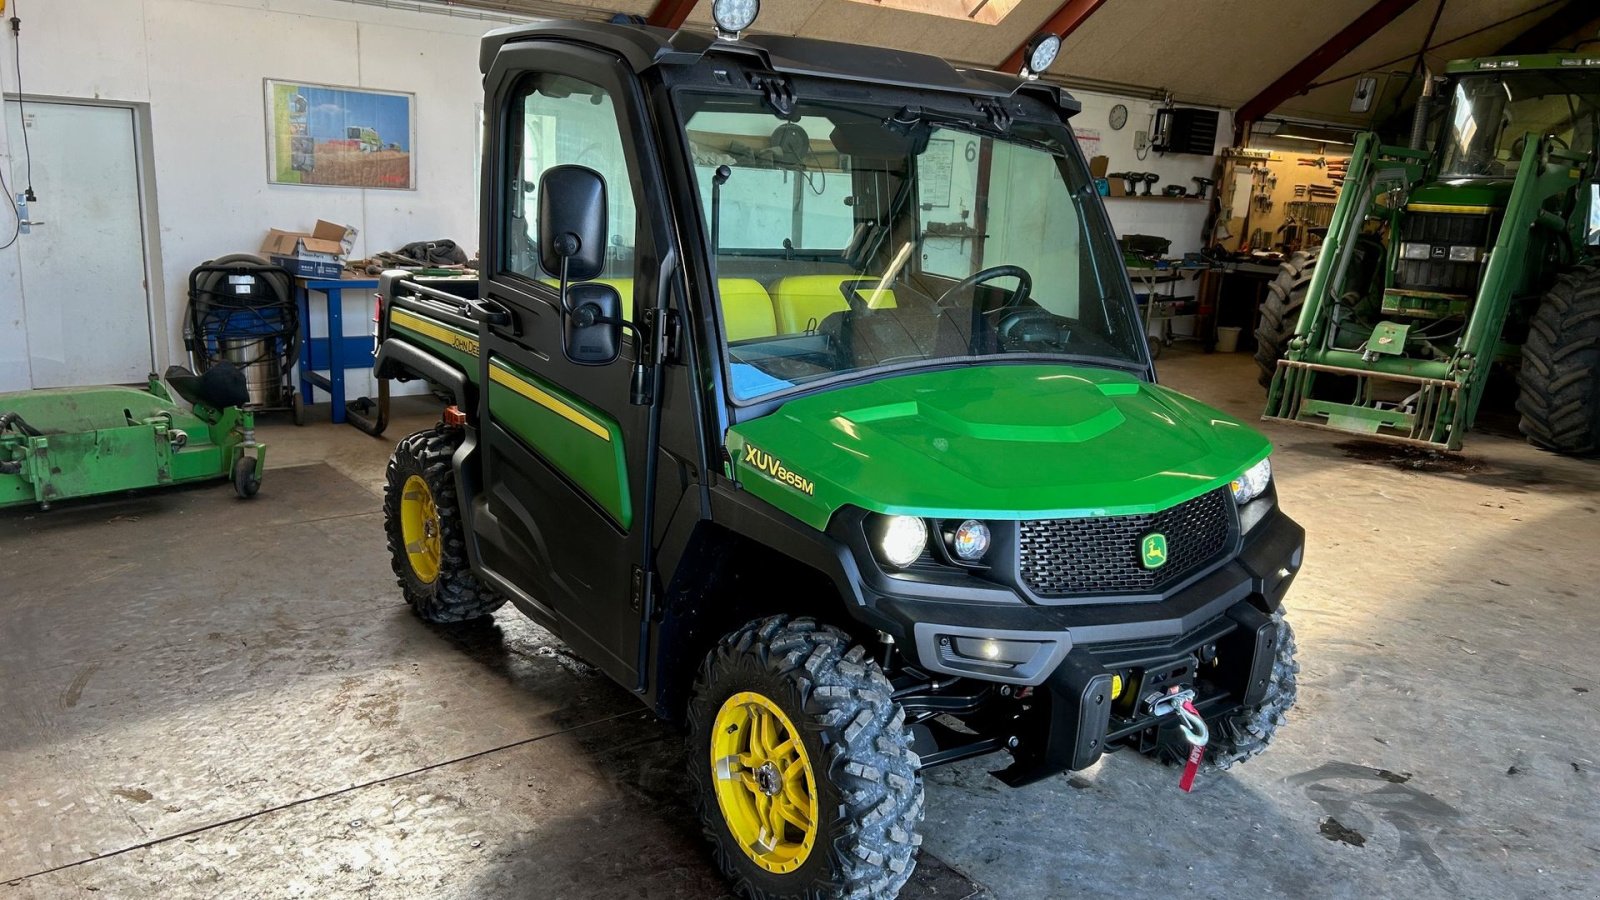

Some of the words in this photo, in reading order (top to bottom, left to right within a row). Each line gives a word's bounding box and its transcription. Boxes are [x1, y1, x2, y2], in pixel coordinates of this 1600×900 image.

[965, 140, 976, 162] 6
[453, 335, 469, 352] JOHN
[468, 340, 480, 356] DEE
